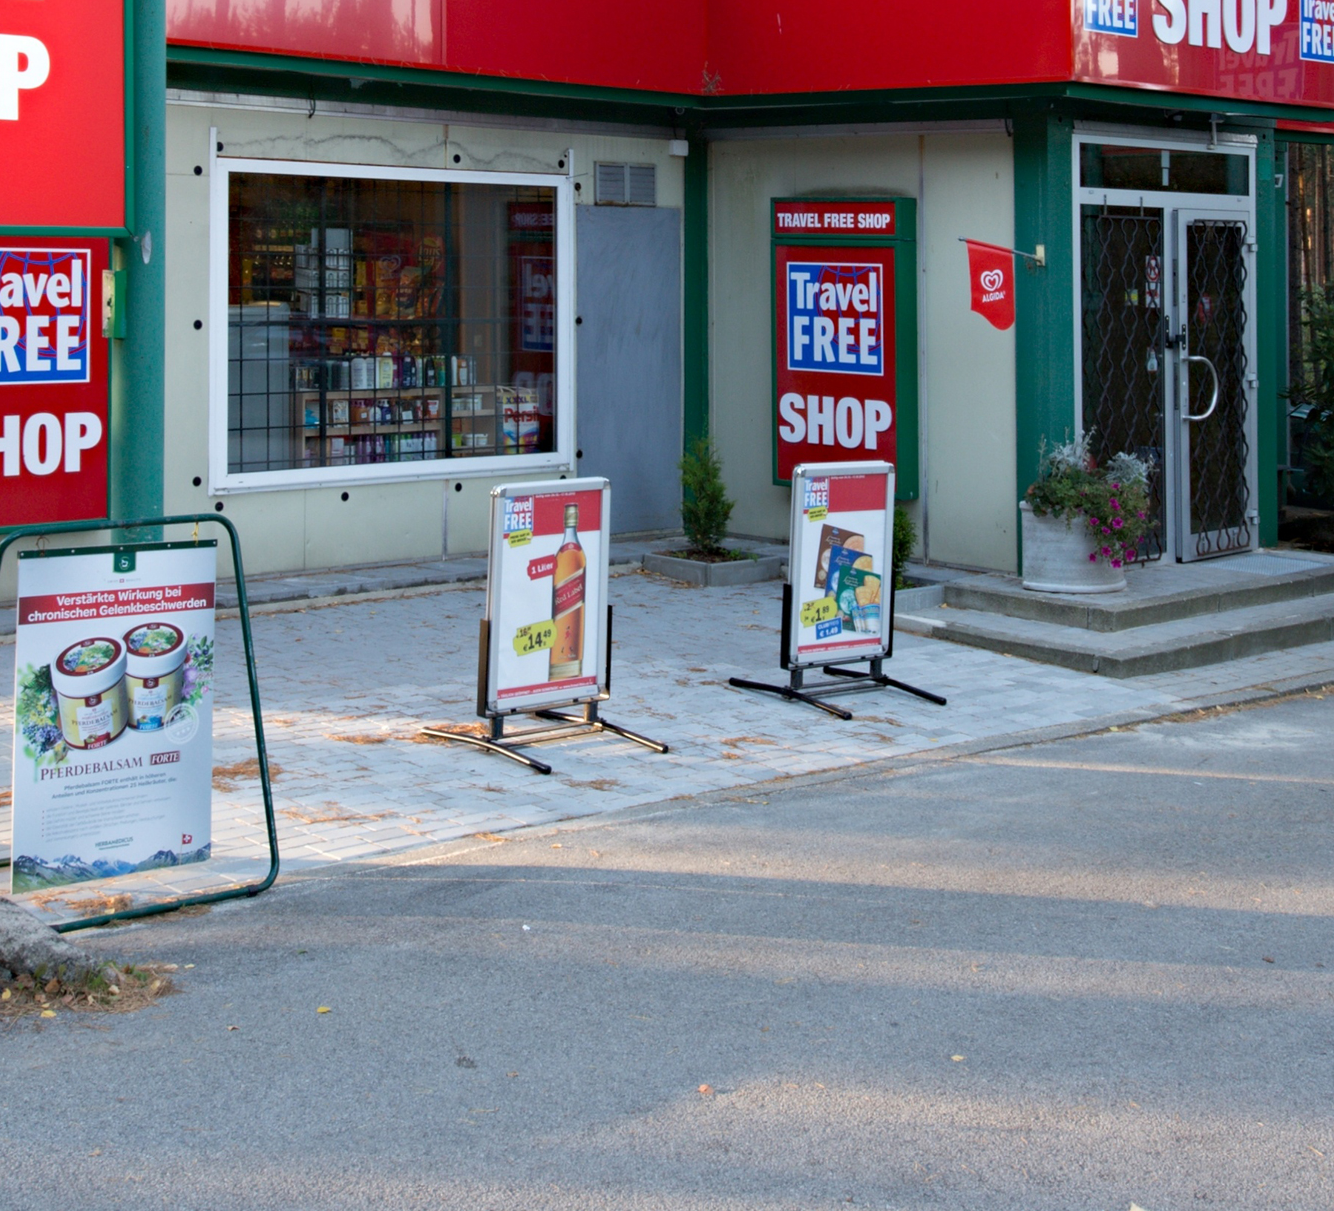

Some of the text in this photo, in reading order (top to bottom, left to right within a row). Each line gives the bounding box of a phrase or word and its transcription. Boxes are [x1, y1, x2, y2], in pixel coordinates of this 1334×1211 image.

[777, 212, 890, 229] TRAVEL FREE SHOP
[790, 272, 877, 312] Travel
[982, 291, 1005, 303] ALGIDA
[793, 316, 878, 365] FREE
[504, 405, 540, 423] Persil
[779, 392, 892, 450] SHOP
[805, 479, 827, 491] Travel
[505, 497, 532, 513] Travel
[804, 492, 827, 506] FREE
[505, 513, 532, 530] FREE
[56, 586, 182, 606] Verstärkte Wirkung bei
[28, 599, 207, 622] chronischen Gelenkbeschwerden
[40, 752, 180, 781] PFERDEBALSAM FORTE
